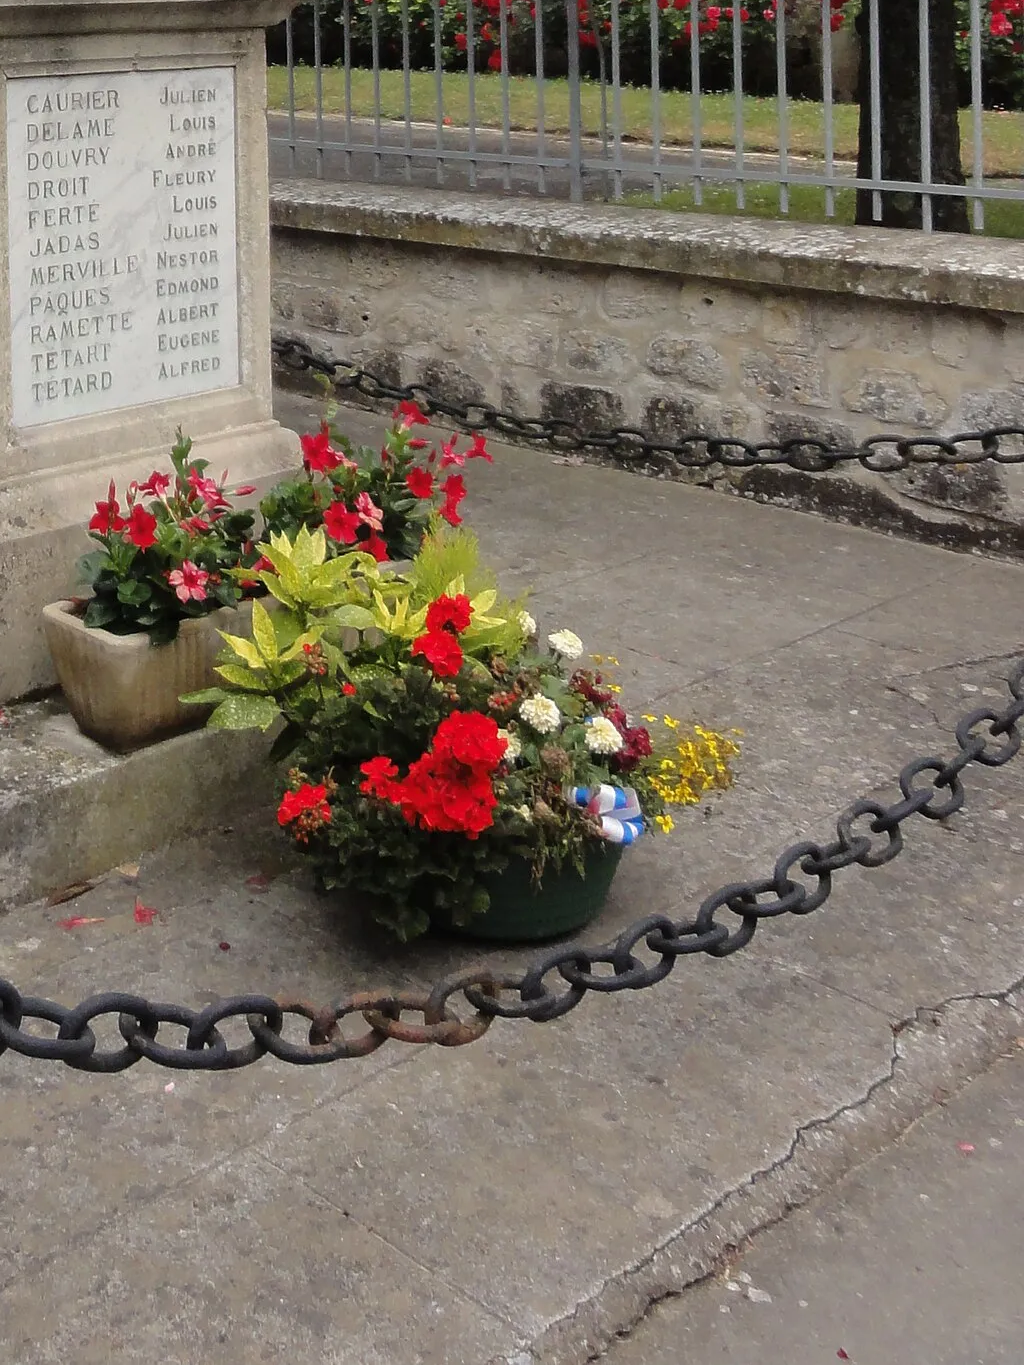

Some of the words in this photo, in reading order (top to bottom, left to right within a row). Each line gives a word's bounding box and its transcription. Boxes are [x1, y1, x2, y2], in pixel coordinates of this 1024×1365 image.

[27, 90, 120, 114] CAURIER
[159, 86, 217, 105] JULIEN
[27, 118, 116, 143] DELAME
[170, 114, 216, 132] LOUIS
[27, 146, 111, 171] DOUVRY
[165, 138, 217, 159] ANDRÉ
[28, 176, 90, 200] DROIT
[152, 170, 217, 188] FLEURY
[28, 199, 101, 230] FERTÉ
[173, 195, 217, 213] LOUIS
[29, 232, 100, 258] JADAS
[163, 223, 218, 241] JULIEN
[29, 255, 139, 287] MERVILLE
[157, 250, 219, 270] NESTOR
[156, 277, 219, 298] EDMOND
[157, 303, 219, 325] ALBERT
[158, 357, 221, 381] ALFRED
